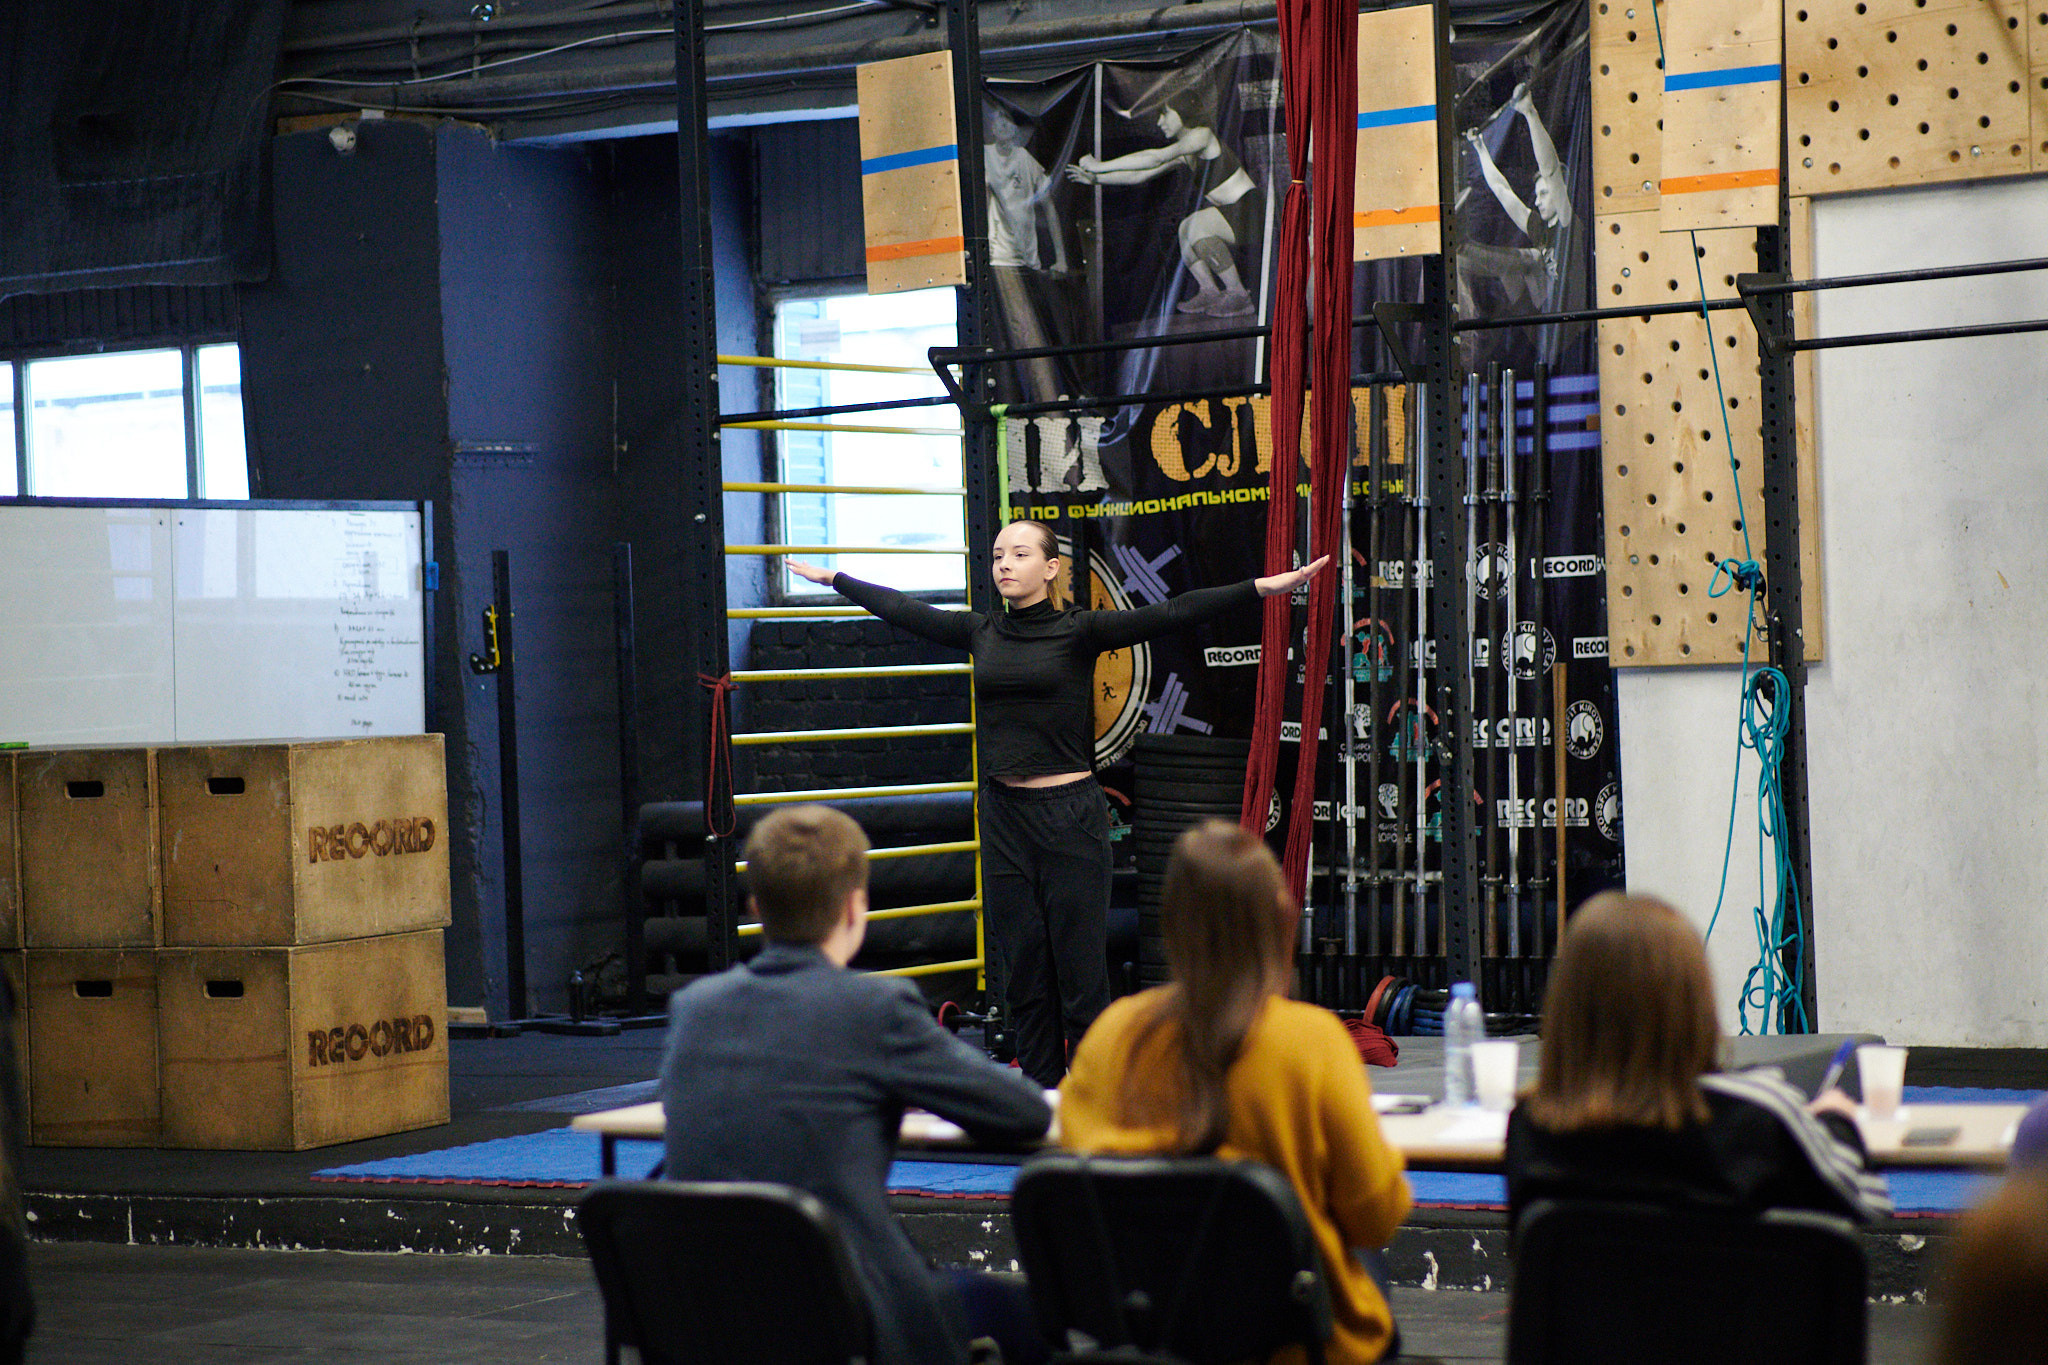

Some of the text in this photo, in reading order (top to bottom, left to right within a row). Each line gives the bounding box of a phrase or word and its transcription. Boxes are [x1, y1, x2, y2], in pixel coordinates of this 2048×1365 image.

[1030, 505, 1060, 520] ПО
[1544, 559, 1595, 573] ECORD
[309, 817, 436, 864] RECORD
[308, 1014, 435, 1068] RECORD
